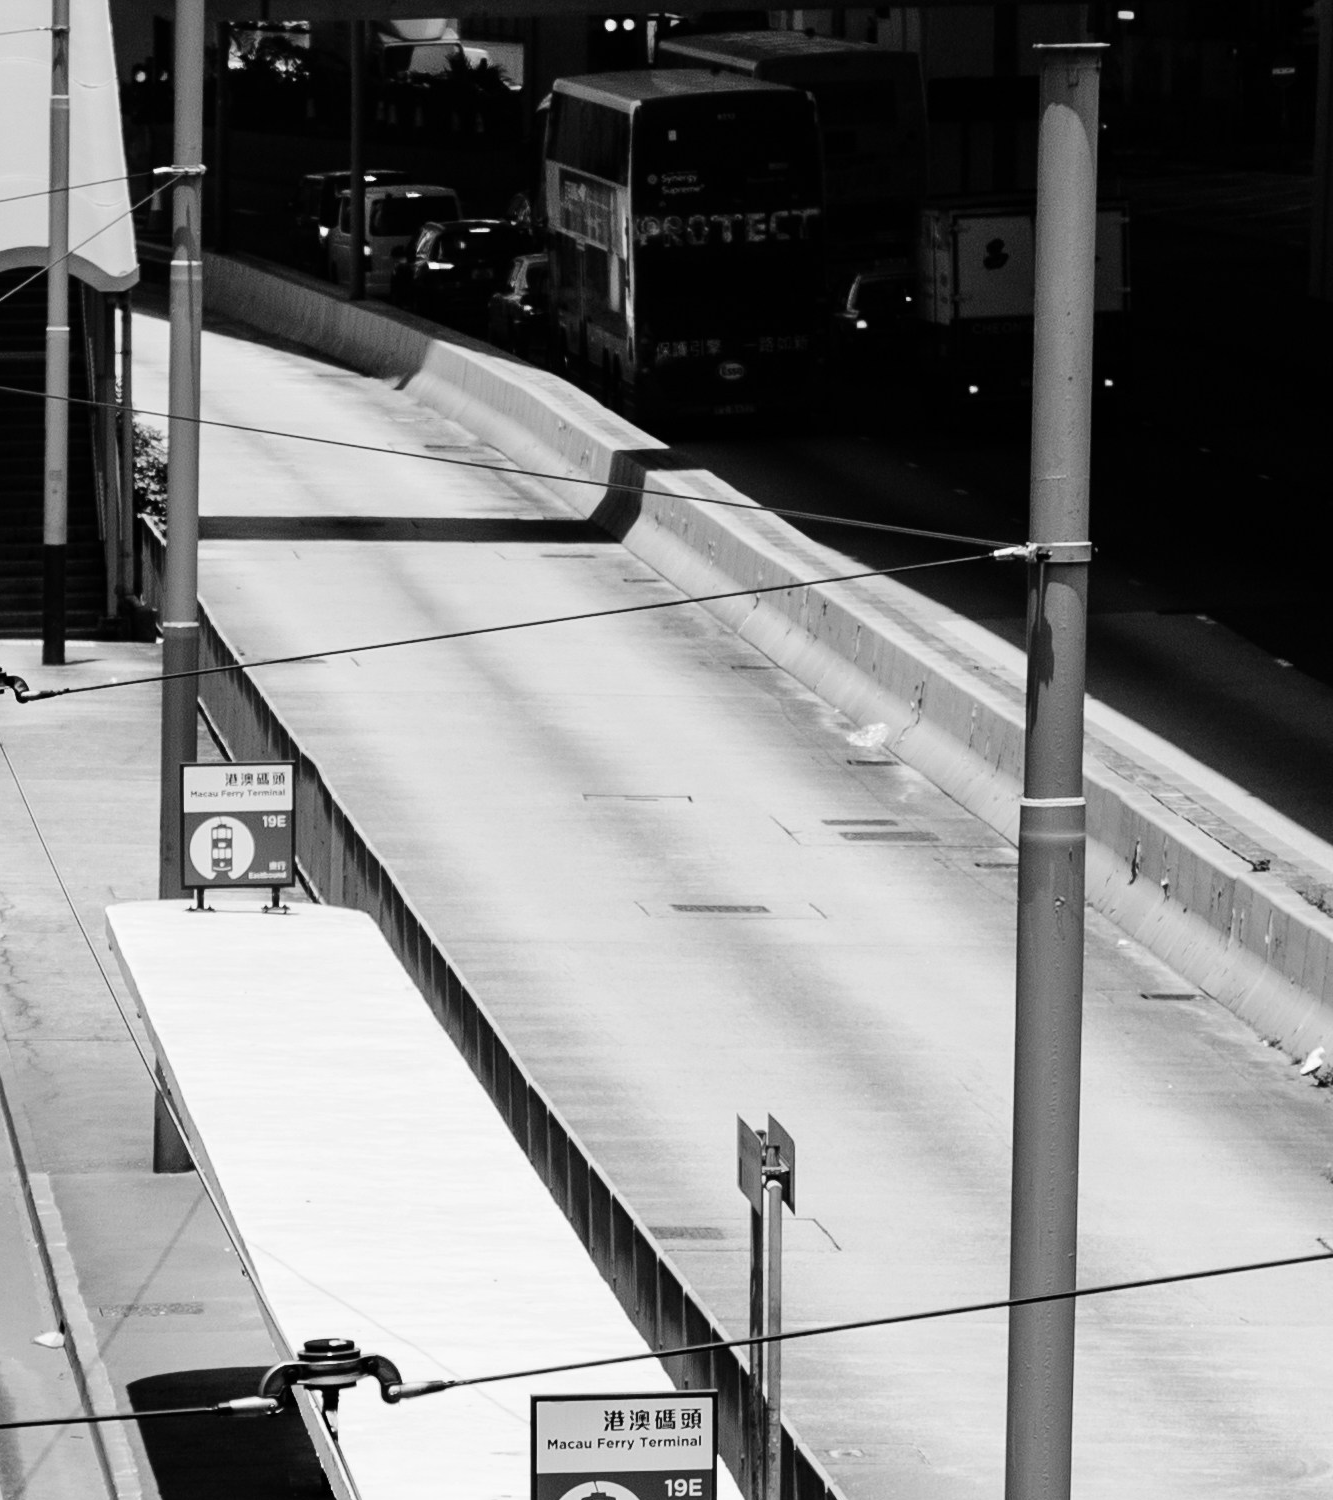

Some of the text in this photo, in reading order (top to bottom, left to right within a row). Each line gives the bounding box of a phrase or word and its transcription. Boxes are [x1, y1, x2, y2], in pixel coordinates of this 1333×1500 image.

[635, 208, 821, 247] PROTECT
[225, 772, 286, 786] 港澳碼頭
[190, 790, 219, 798] Macau
[221, 790, 245, 798] Ferry
[262, 814, 287, 828] 19E
[604, 1409, 702, 1432] 港澳碼頭
[547, 1435, 702, 1450] Macau Ferry Terminal
[664, 1478, 703, 1497] 19E
